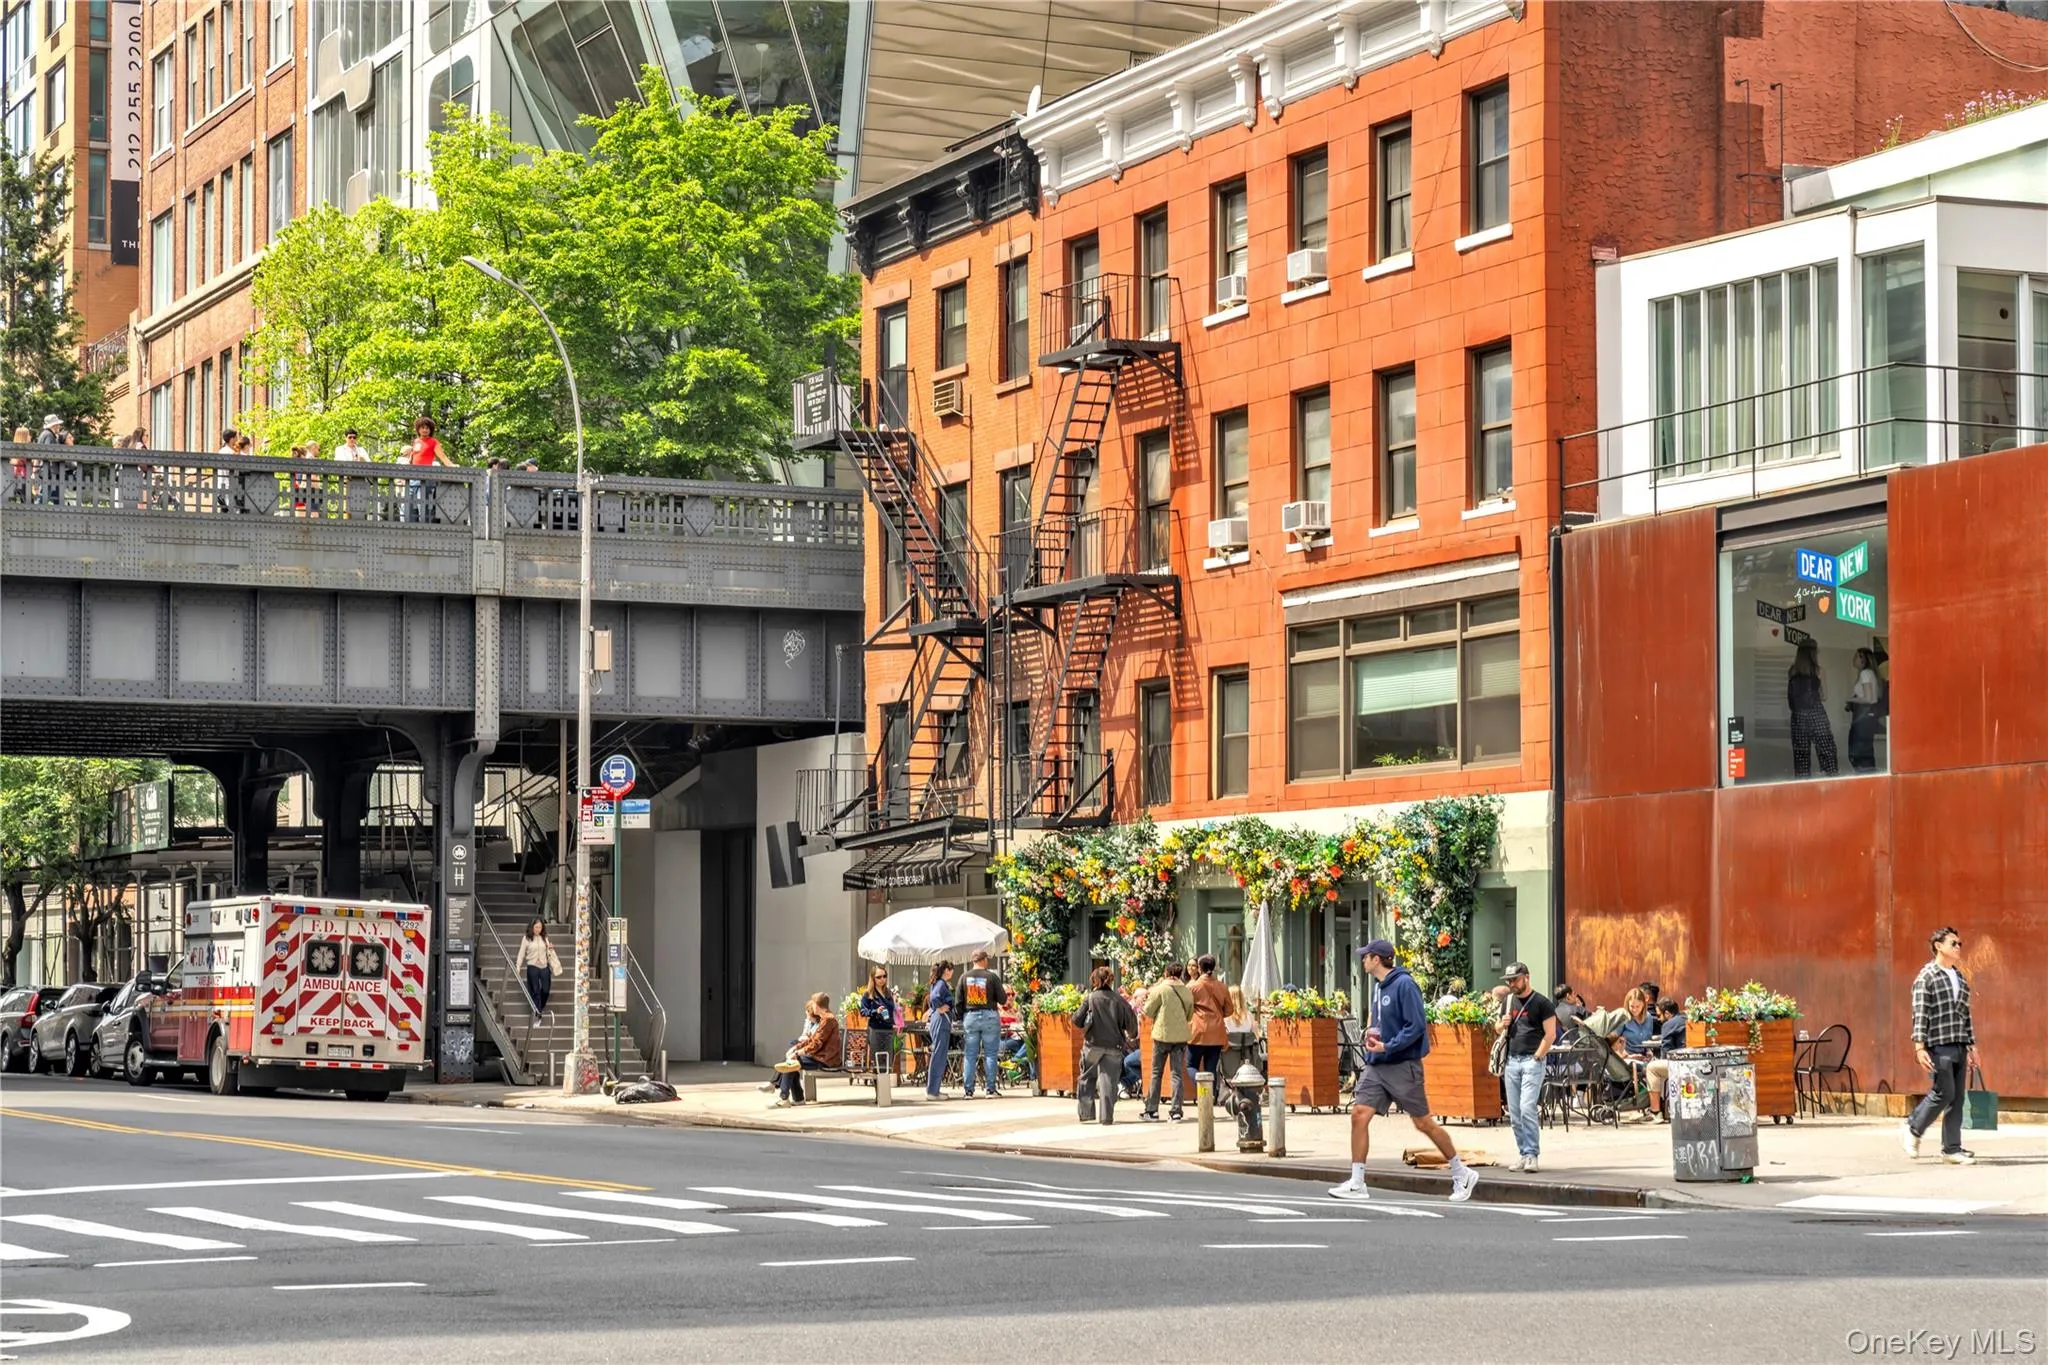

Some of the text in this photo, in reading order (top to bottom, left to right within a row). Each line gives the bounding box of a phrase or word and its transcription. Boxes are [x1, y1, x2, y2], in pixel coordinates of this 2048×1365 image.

[127, 16, 140, 169] 212 255 2200
[1801, 546, 1864, 582] DEAR NEW
[1760, 605, 1804, 622] DEAR NEW
[1839, 592, 1872, 623] YORK
[303, 978, 381, 993] AMBULANCE
[310, 1017, 375, 1029] KEEP BACK
